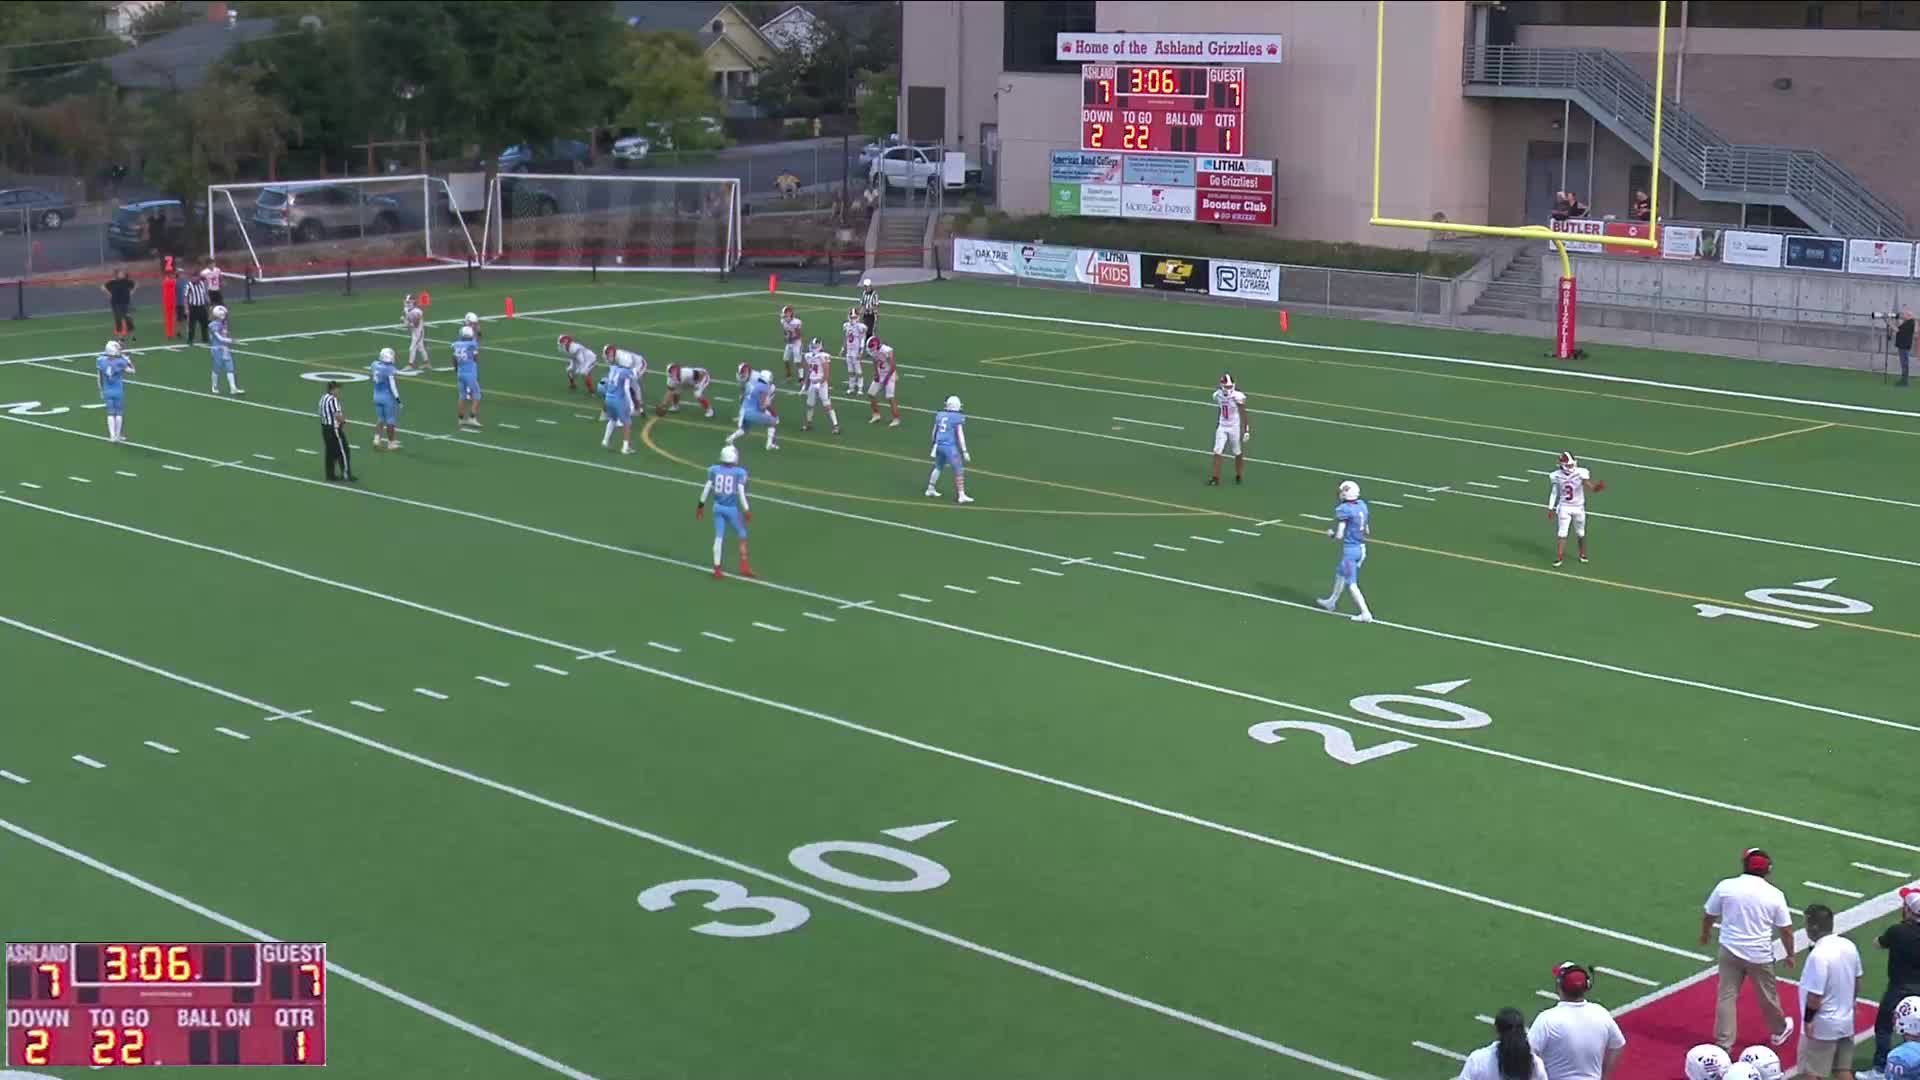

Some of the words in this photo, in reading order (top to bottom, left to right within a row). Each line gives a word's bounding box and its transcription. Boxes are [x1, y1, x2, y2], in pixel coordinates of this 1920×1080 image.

[1075, 40, 1109, 55] Home
[1113, 40, 1126, 55] of
[1129, 40, 1148, 55] the
[1155, 40, 1202, 56] Ashland
[1208, 41, 1263, 56] Grizzlies
[1084, 67, 1114, 80] ASHLAND
[1132, 69, 1174, 93] 3:06
[1210, 69, 1242, 82] GUEST
[1099, 80, 1110, 103] 7
[1229, 84, 1240, 106] 7
[1083, 110, 1114, 123] DOWN
[1123, 111, 1136, 124] TO
[1138, 112, 1153, 124] GO
[1165, 113, 1188, 126] BALL
[1190, 114, 1203, 126] ON
[1215, 114, 1236, 127] QTR
[1091, 124, 1104, 148] 2
[1123, 125, 1150, 149] 22
[1226, 129, 1232, 152] 1
[1213, 160, 1245, 171] LITHIA
[1210, 175, 1221, 186] Go
[1222, 175, 1259, 188] Grizzlies!
[1202, 198, 1241, 210] Booster
[1244, 201, 1267, 212] Club
[1553, 221, 1600, 235] BUTLER
[976, 249, 991, 258] OAK
[1086, 248, 1099, 283] 4
[1101, 265, 1129, 282] KIDS
[938, 416, 949, 433] 5
[714, 474, 734, 495] 88
[1564, 484, 1574, 501] 3
[1692, 587, 1874, 630] 10
[1247, 693, 1493, 765] 20
[637, 840, 951, 938] 30
